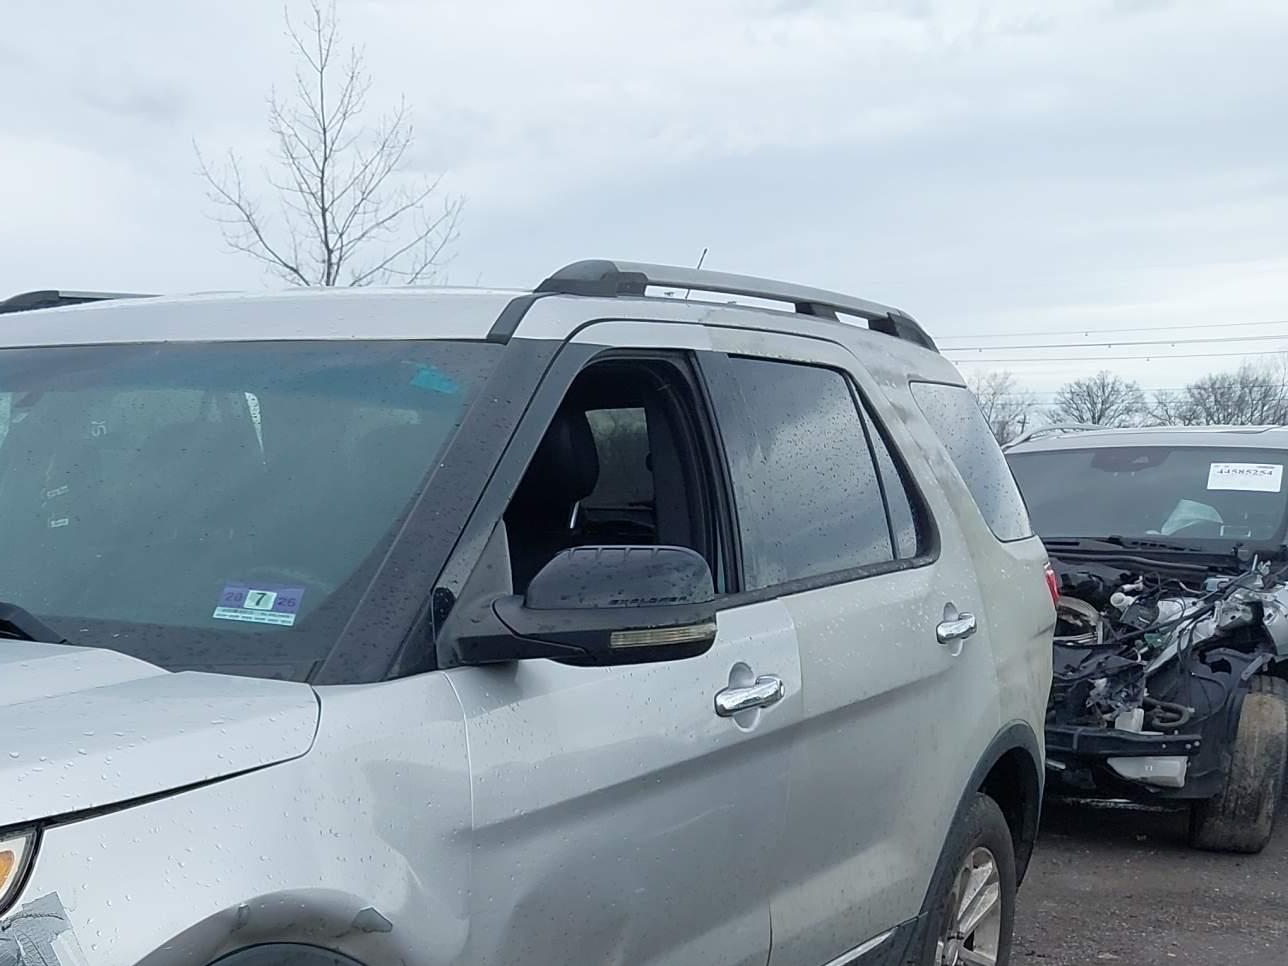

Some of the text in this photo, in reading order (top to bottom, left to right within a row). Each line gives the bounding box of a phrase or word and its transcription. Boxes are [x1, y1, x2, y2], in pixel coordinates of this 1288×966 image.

[224, 592, 296, 607] 20 7 26
